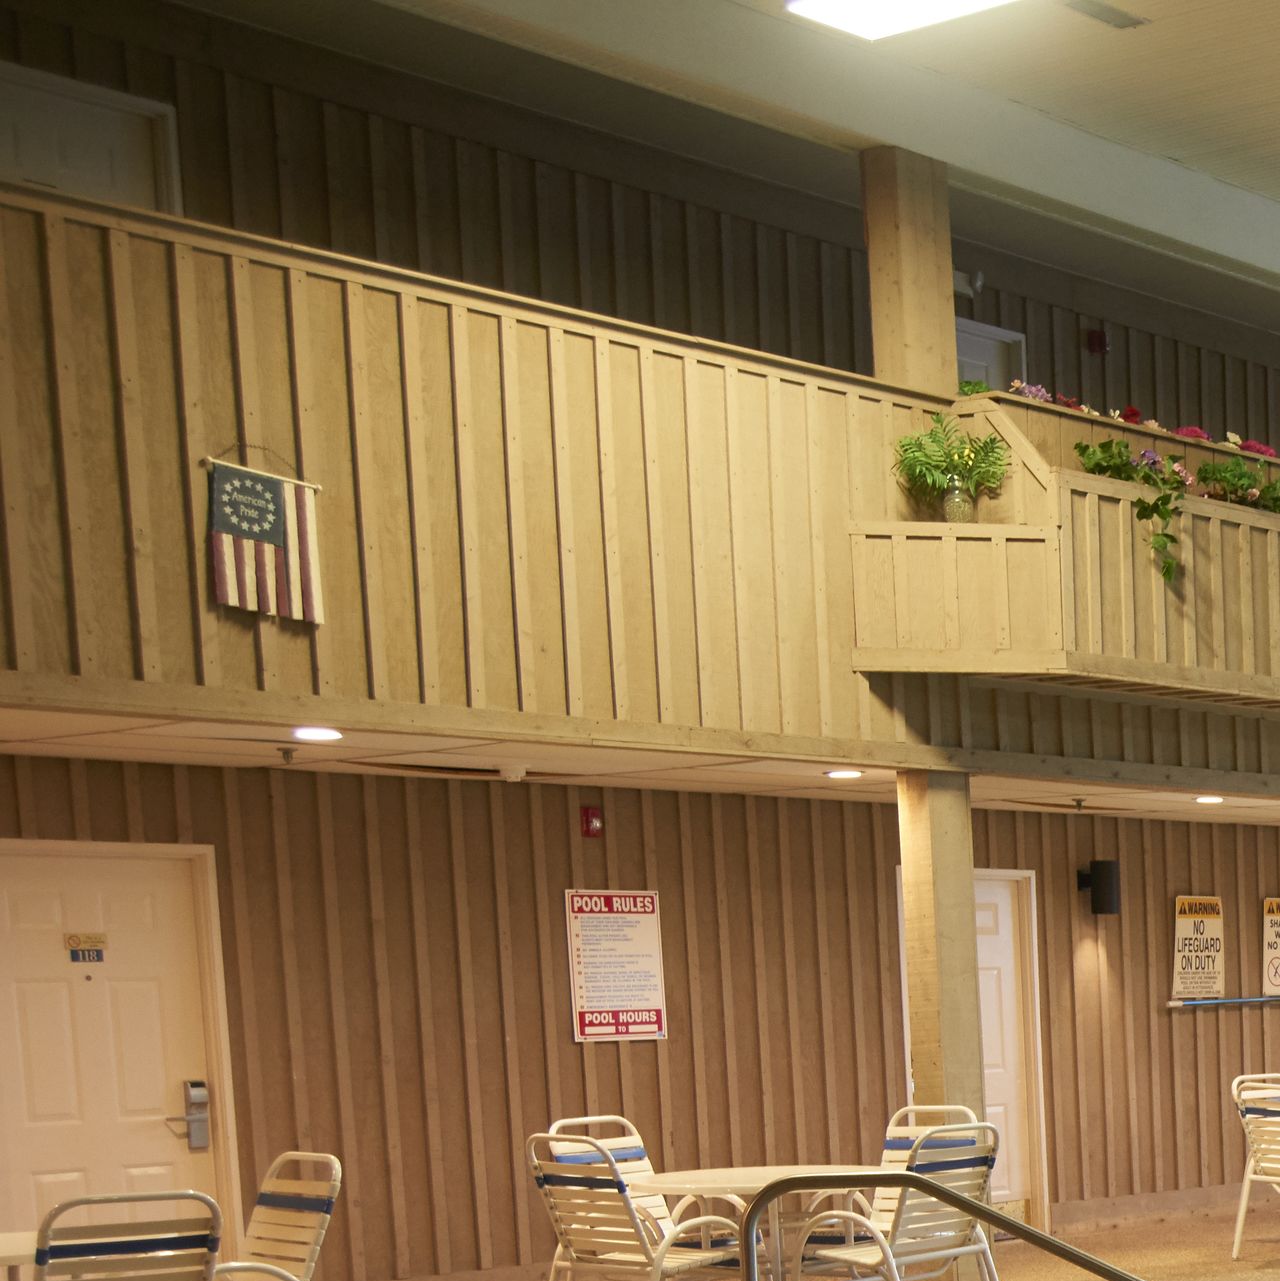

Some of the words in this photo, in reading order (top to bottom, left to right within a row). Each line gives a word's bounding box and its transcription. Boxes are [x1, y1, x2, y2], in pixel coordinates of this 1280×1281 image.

[231, 491, 267, 508] American
[239, 504, 260, 519] Pride
[573, 896, 609, 912] POOL
[612, 896, 653, 912] RULES
[1187, 902, 1220, 915] WARNING
[1193, 920, 1205, 935] NO
[1177, 937, 1221, 953] LIFEGUARD
[1267, 941, 1279, 950] NO
[78, 950, 98, 961] 118
[1181, 955, 1193, 971] ON
[1195, 955, 1216, 971] DUTY
[585, 1012, 615, 1025] POOL
[619, 1011, 657, 1024] HOURS
